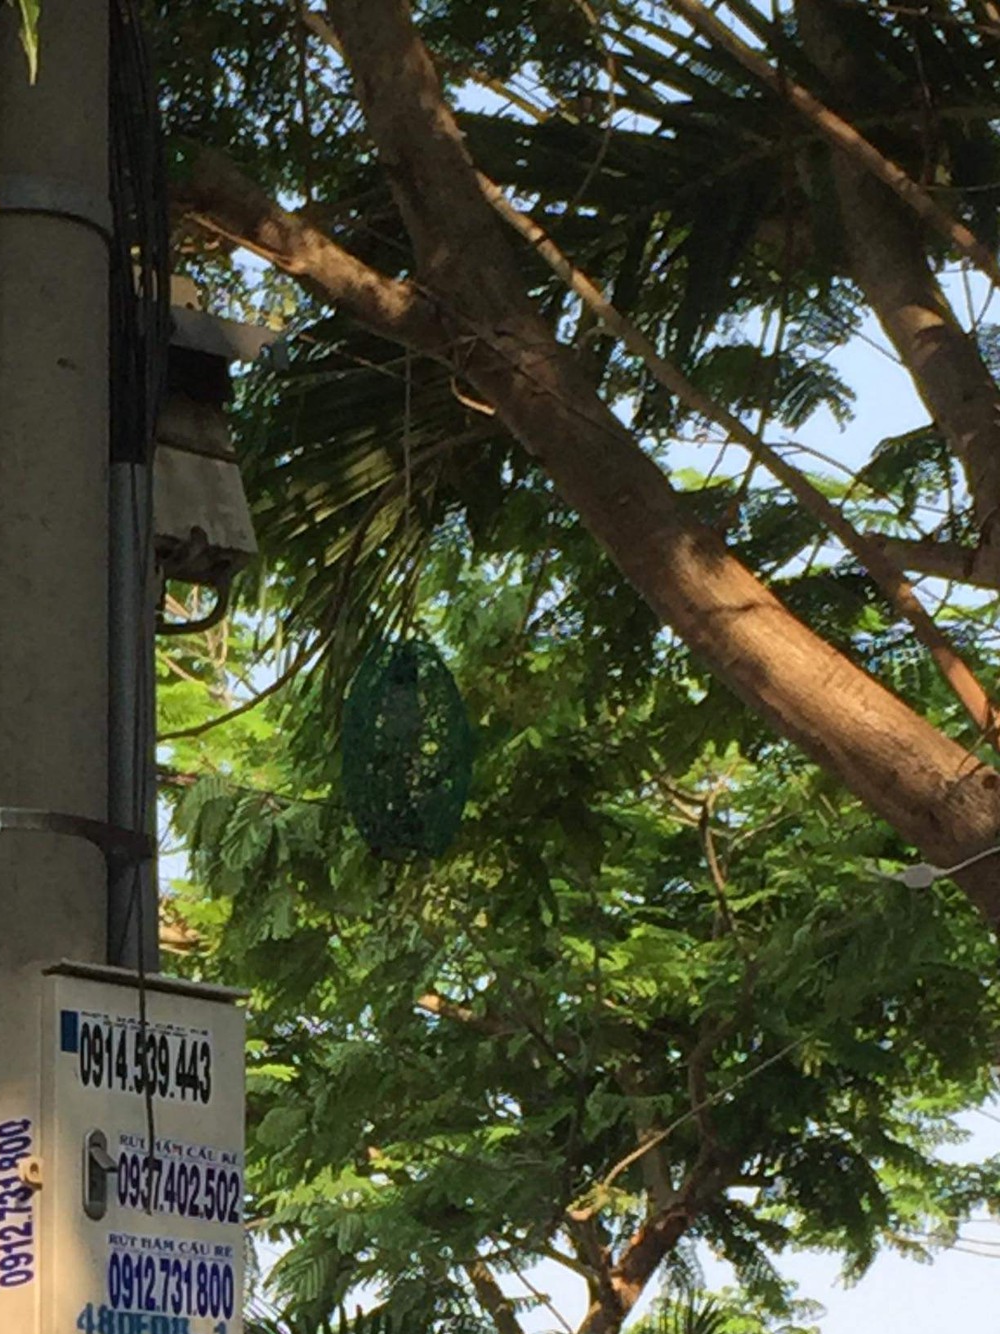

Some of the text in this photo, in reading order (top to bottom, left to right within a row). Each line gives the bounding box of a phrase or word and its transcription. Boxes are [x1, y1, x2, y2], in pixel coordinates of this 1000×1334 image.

[80, 1021, 212, 1104] 0914.539.443
[118, 1152, 240, 1224] 0937.402.502
[108, 1252, 235, 1320] 0912.731.800
